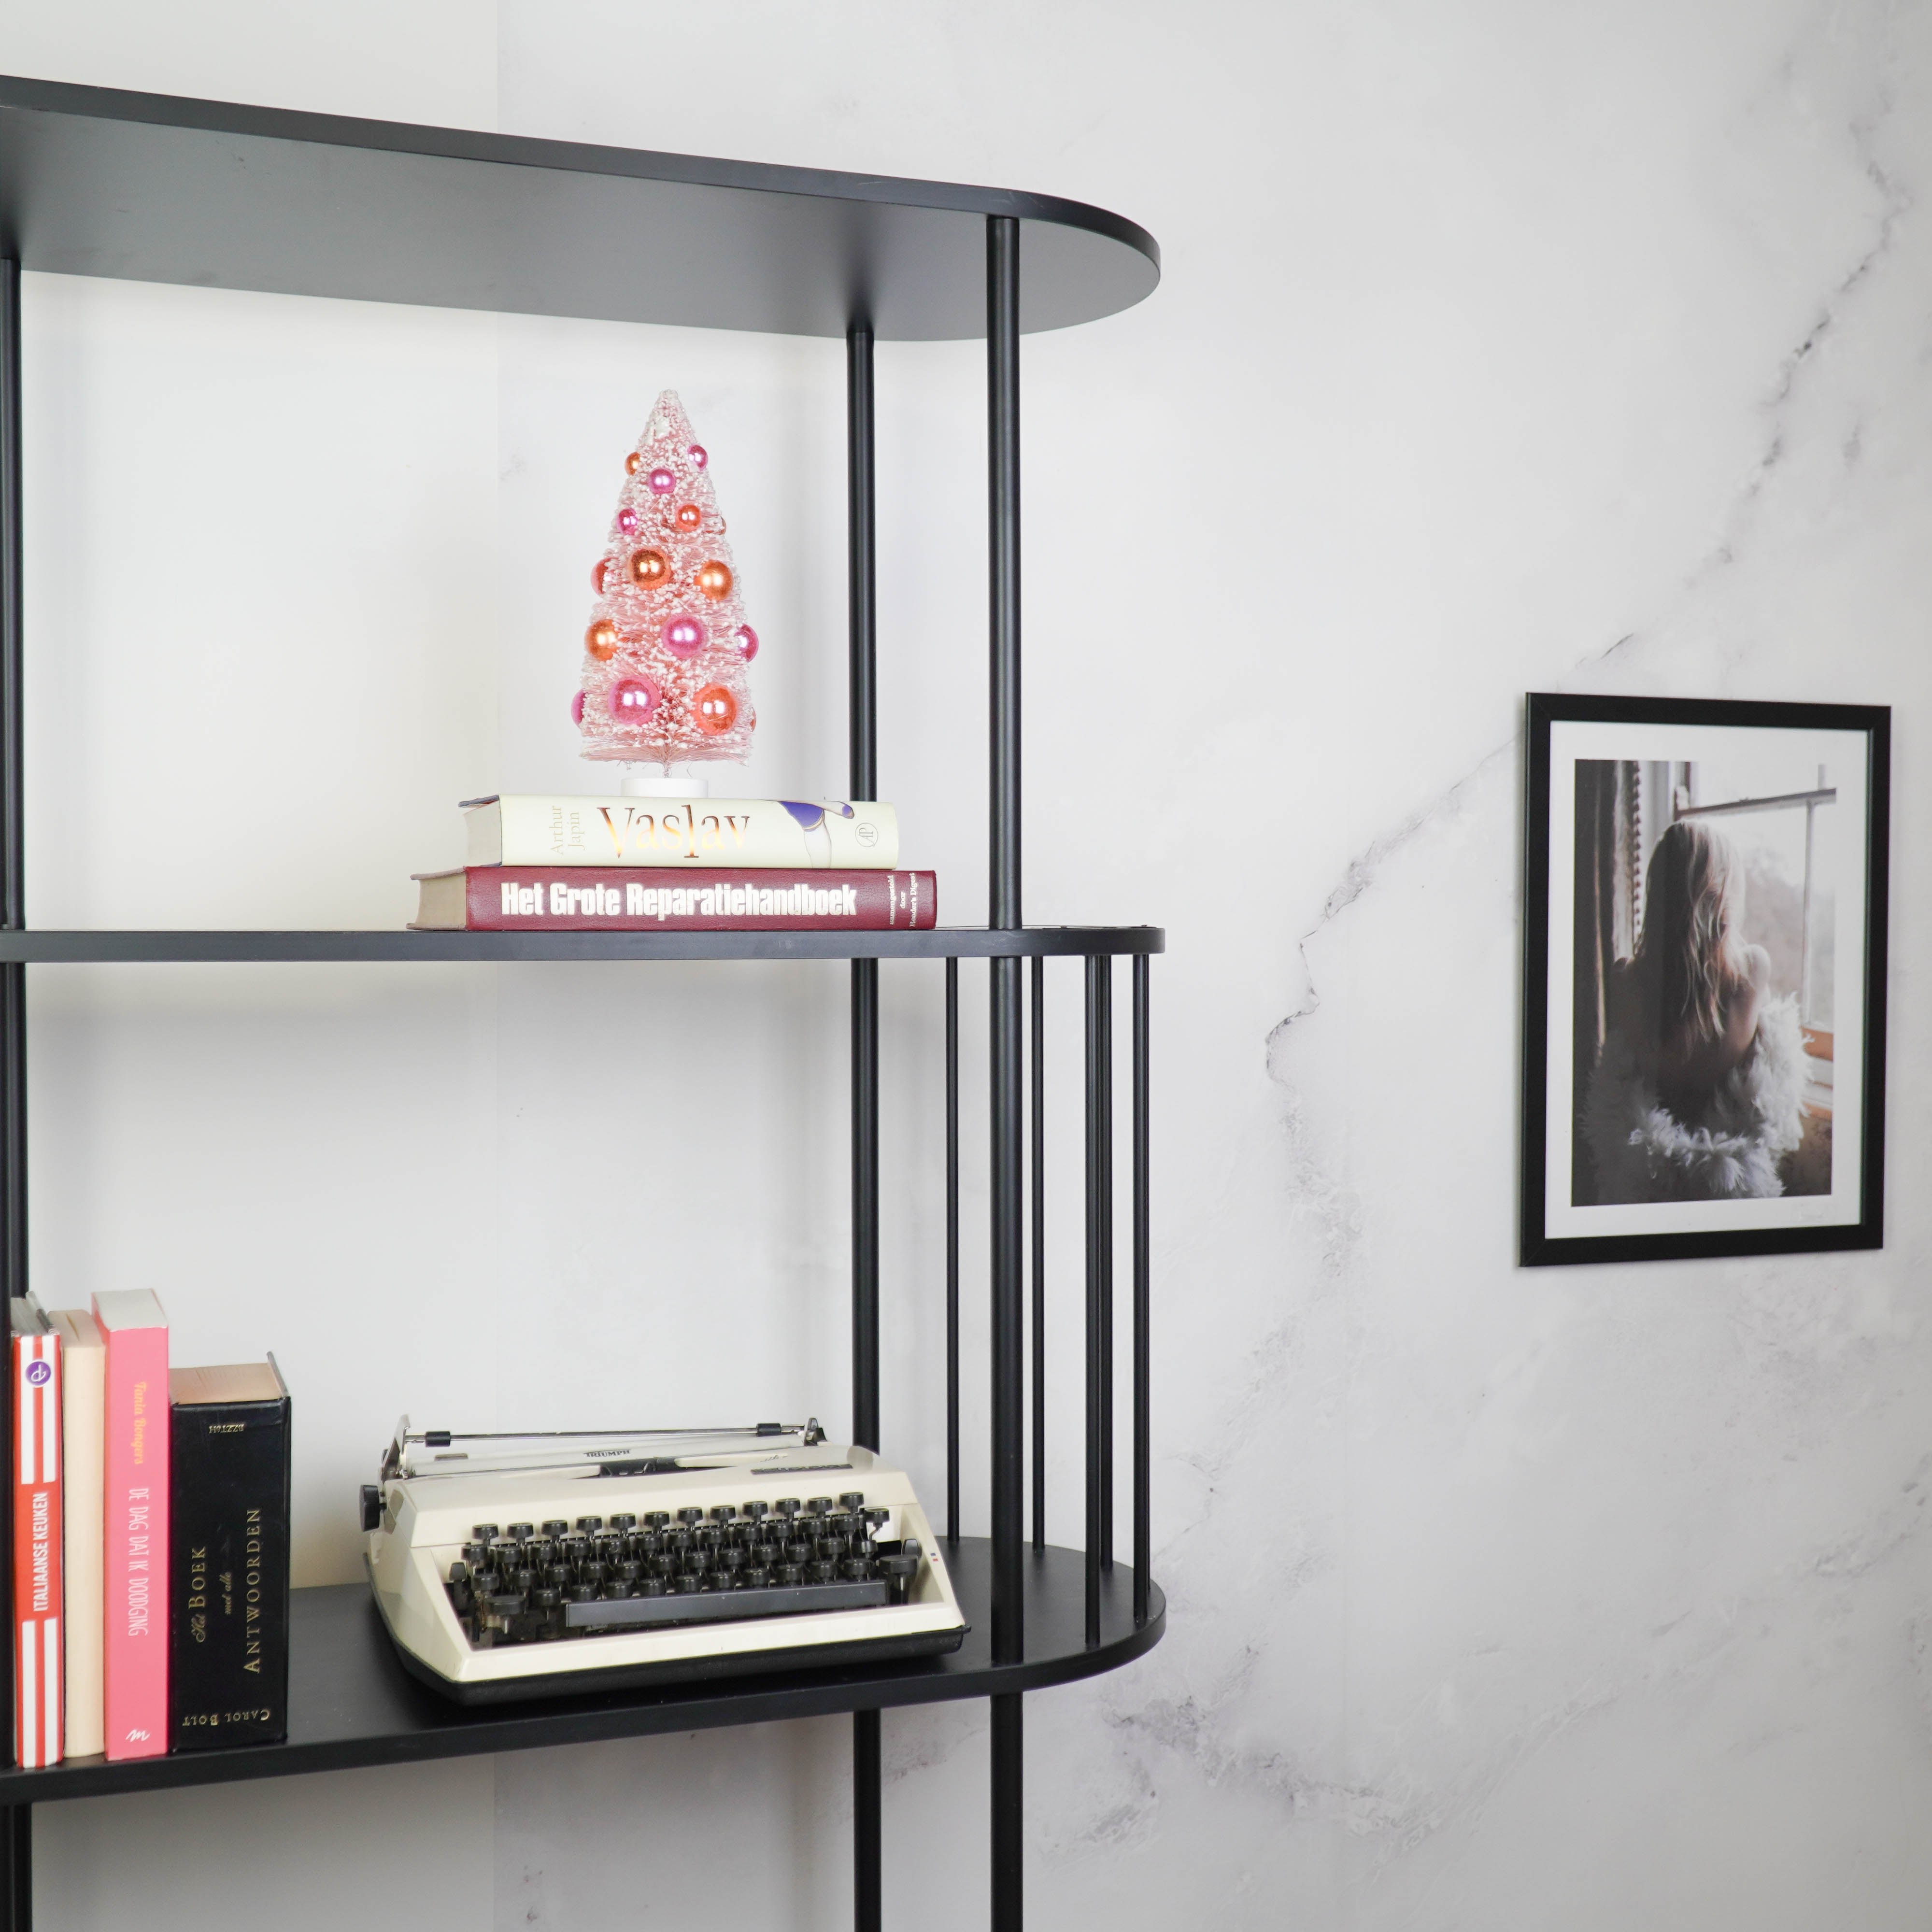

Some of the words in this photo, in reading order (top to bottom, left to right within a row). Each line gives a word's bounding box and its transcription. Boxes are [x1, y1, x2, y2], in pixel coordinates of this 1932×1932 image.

[549, 806, 563, 855] Arthur
[567, 812, 585, 850] Japin
[597, 804, 750, 858] Vaslav
[501, 882, 543, 916] Het
[550, 882, 621, 916] Grote
[627, 883, 857, 921] Reparatiehandboek
[909, 873, 918, 896] Digest
[134, 1381, 146, 1415] Tania
[131, 1418, 146, 1465] Bongers
[128, 1487, 149, 1501] DE
[33, 1492, 48, 1541] KEUKEN
[128, 1506, 149, 1531] DAG
[128, 1535, 149, 1556] DAT
[33, 1541, 49, 1611] ITALIAANSE
[128, 1560, 149, 1572] IK
[188, 1546, 206, 1609] BOEK
[220, 1571, 231, 1592] alle
[128, 1577, 149, 1636] DOODGING
[243, 1509, 261, 1674] ANTWOORDEN
[182, 1714, 219, 1726] BOLT
[224, 1709, 270, 1723] CAROL
